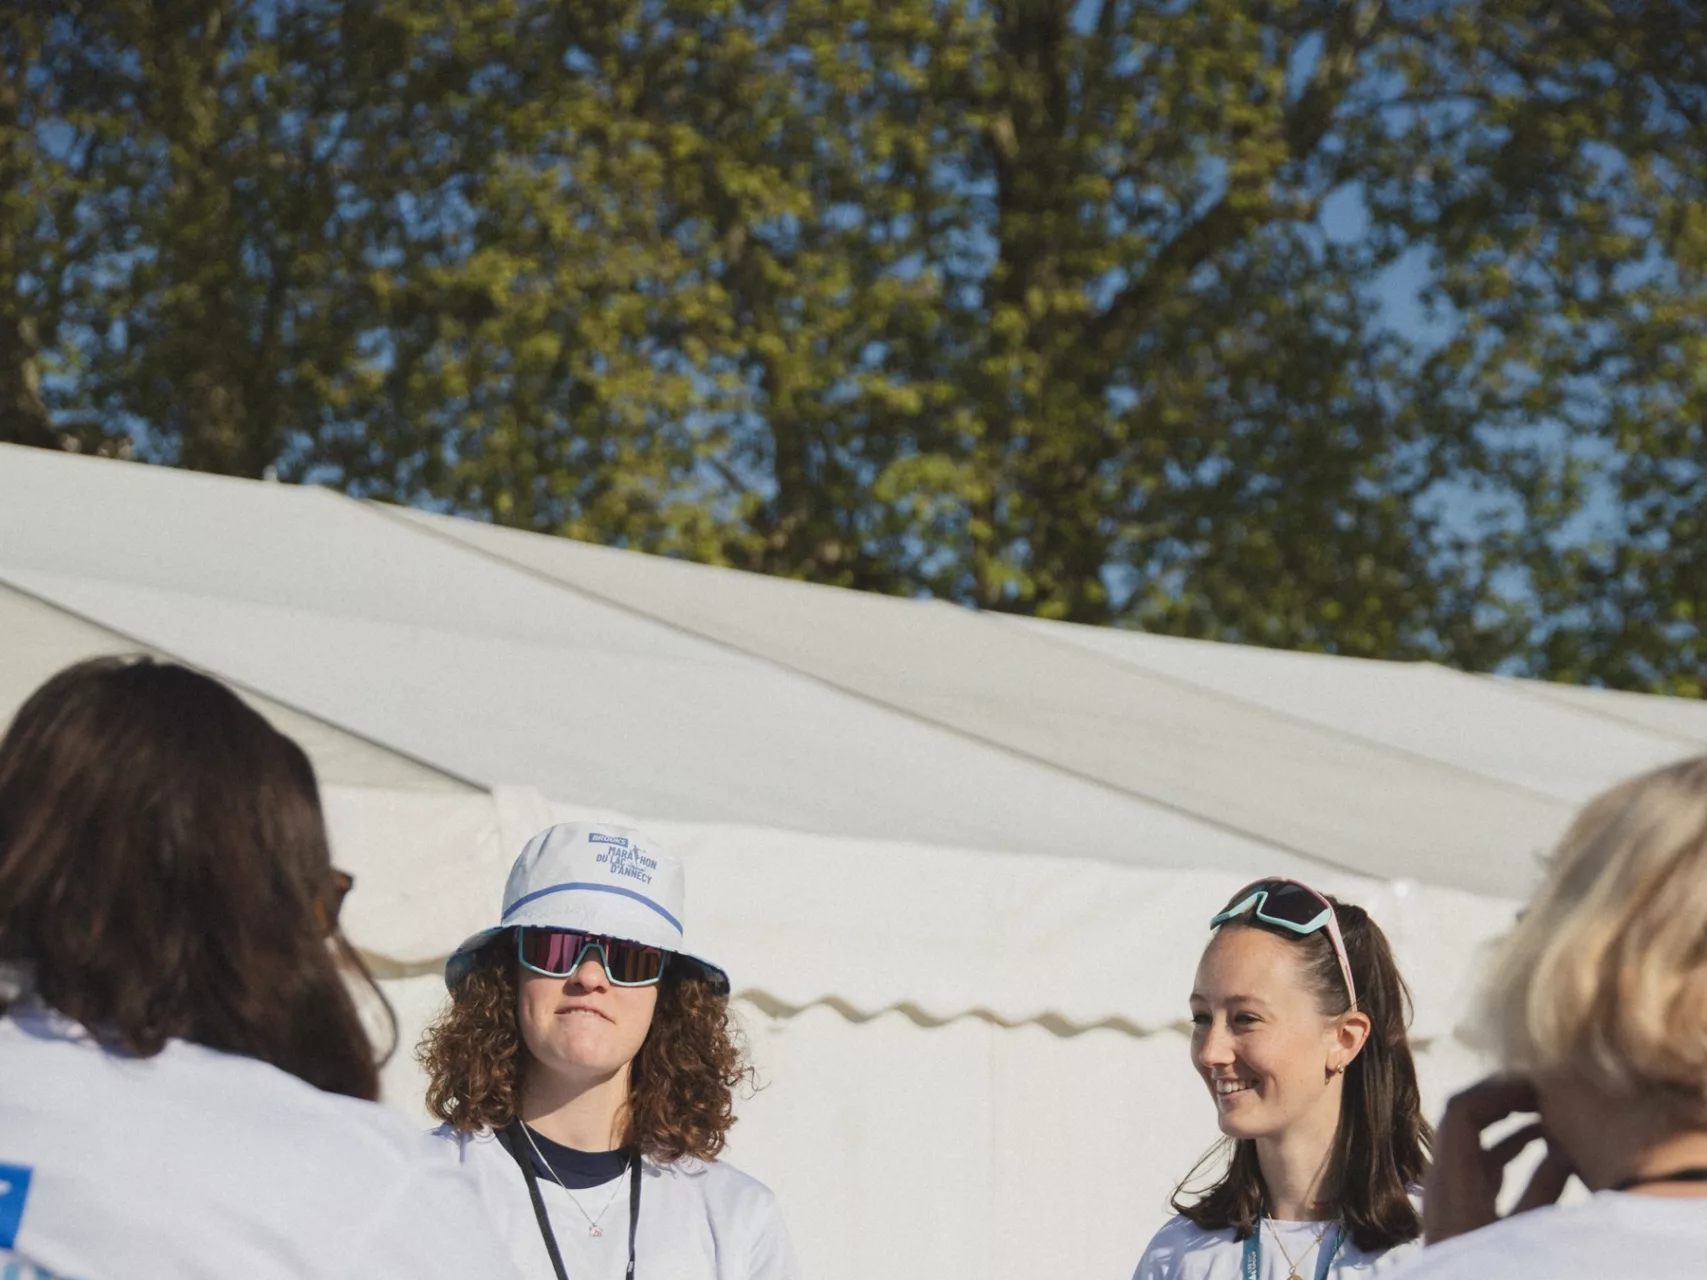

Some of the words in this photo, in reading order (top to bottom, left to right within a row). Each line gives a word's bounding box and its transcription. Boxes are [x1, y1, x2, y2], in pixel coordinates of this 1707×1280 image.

[591, 834, 627, 846] BROOKS
[595, 853, 608, 863] DU
[610, 854, 626, 866] LAC
[610, 863, 653, 885] D'ANNECY
